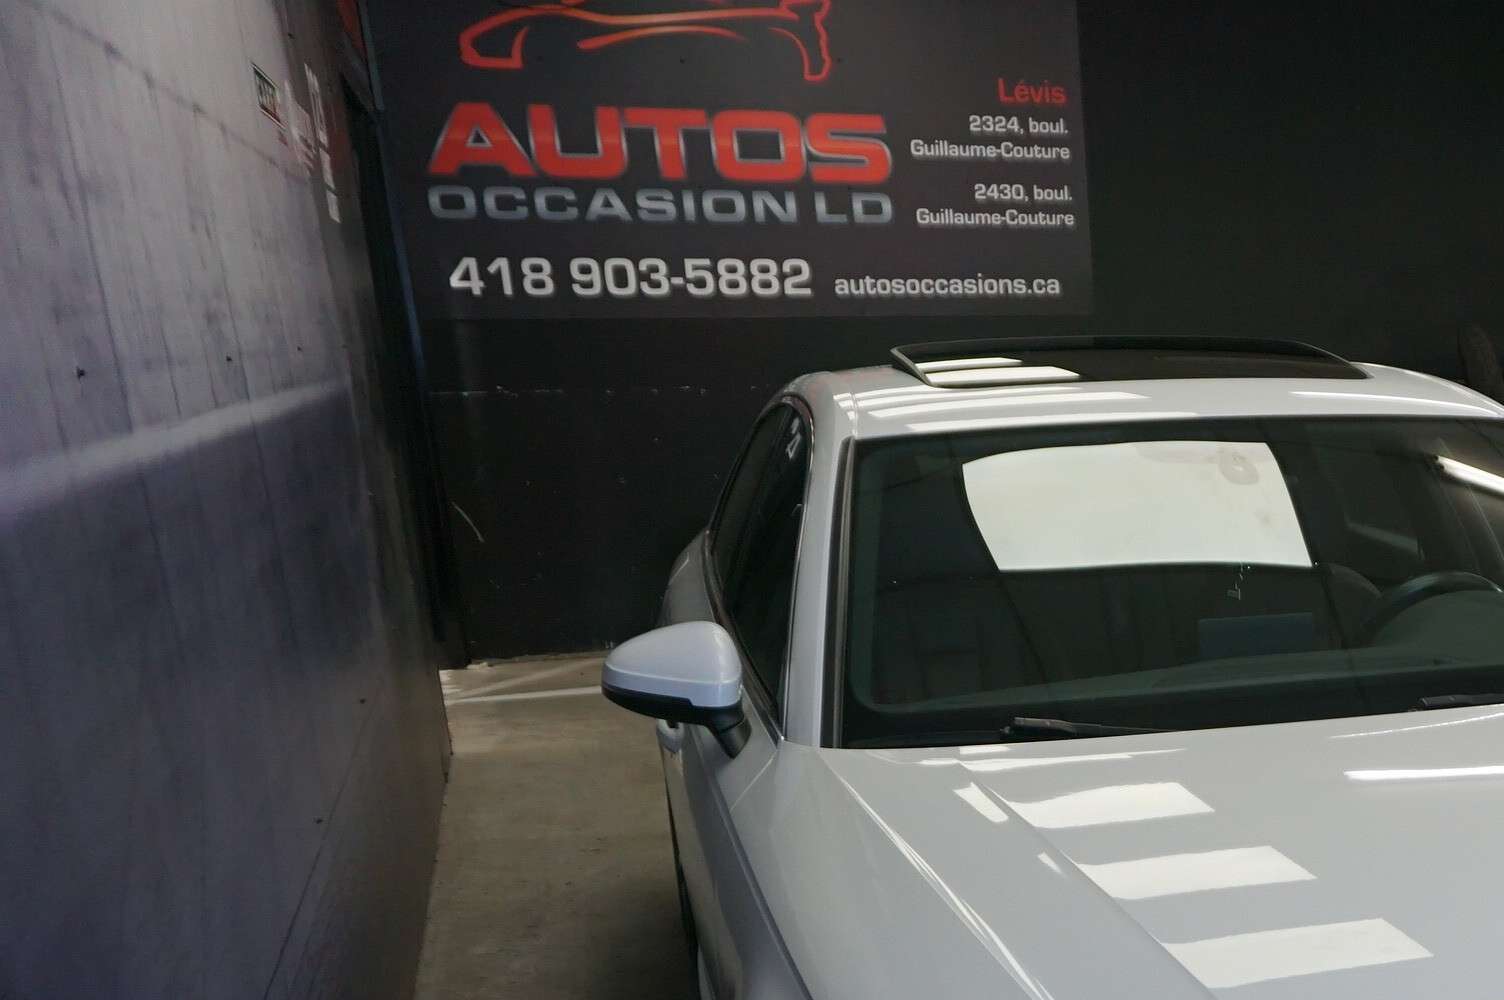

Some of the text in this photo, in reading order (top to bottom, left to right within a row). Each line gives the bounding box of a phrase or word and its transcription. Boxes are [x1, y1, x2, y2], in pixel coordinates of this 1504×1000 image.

[998, 79, 1067, 103] Lévis
[968, 115, 1069, 135] 2324, boul.
[428, 102, 893, 183] AUTOS
[910, 140, 1070, 160] Guillaume-Couture
[427, 185, 893, 223] OCCASION LD
[973, 183, 1073, 204] 2430, boul.
[916, 208, 1074, 227] Guillaume-Couture
[449, 256, 813, 296] 418 903-5882
[833, 273, 1061, 296] autosoccasions.ca
